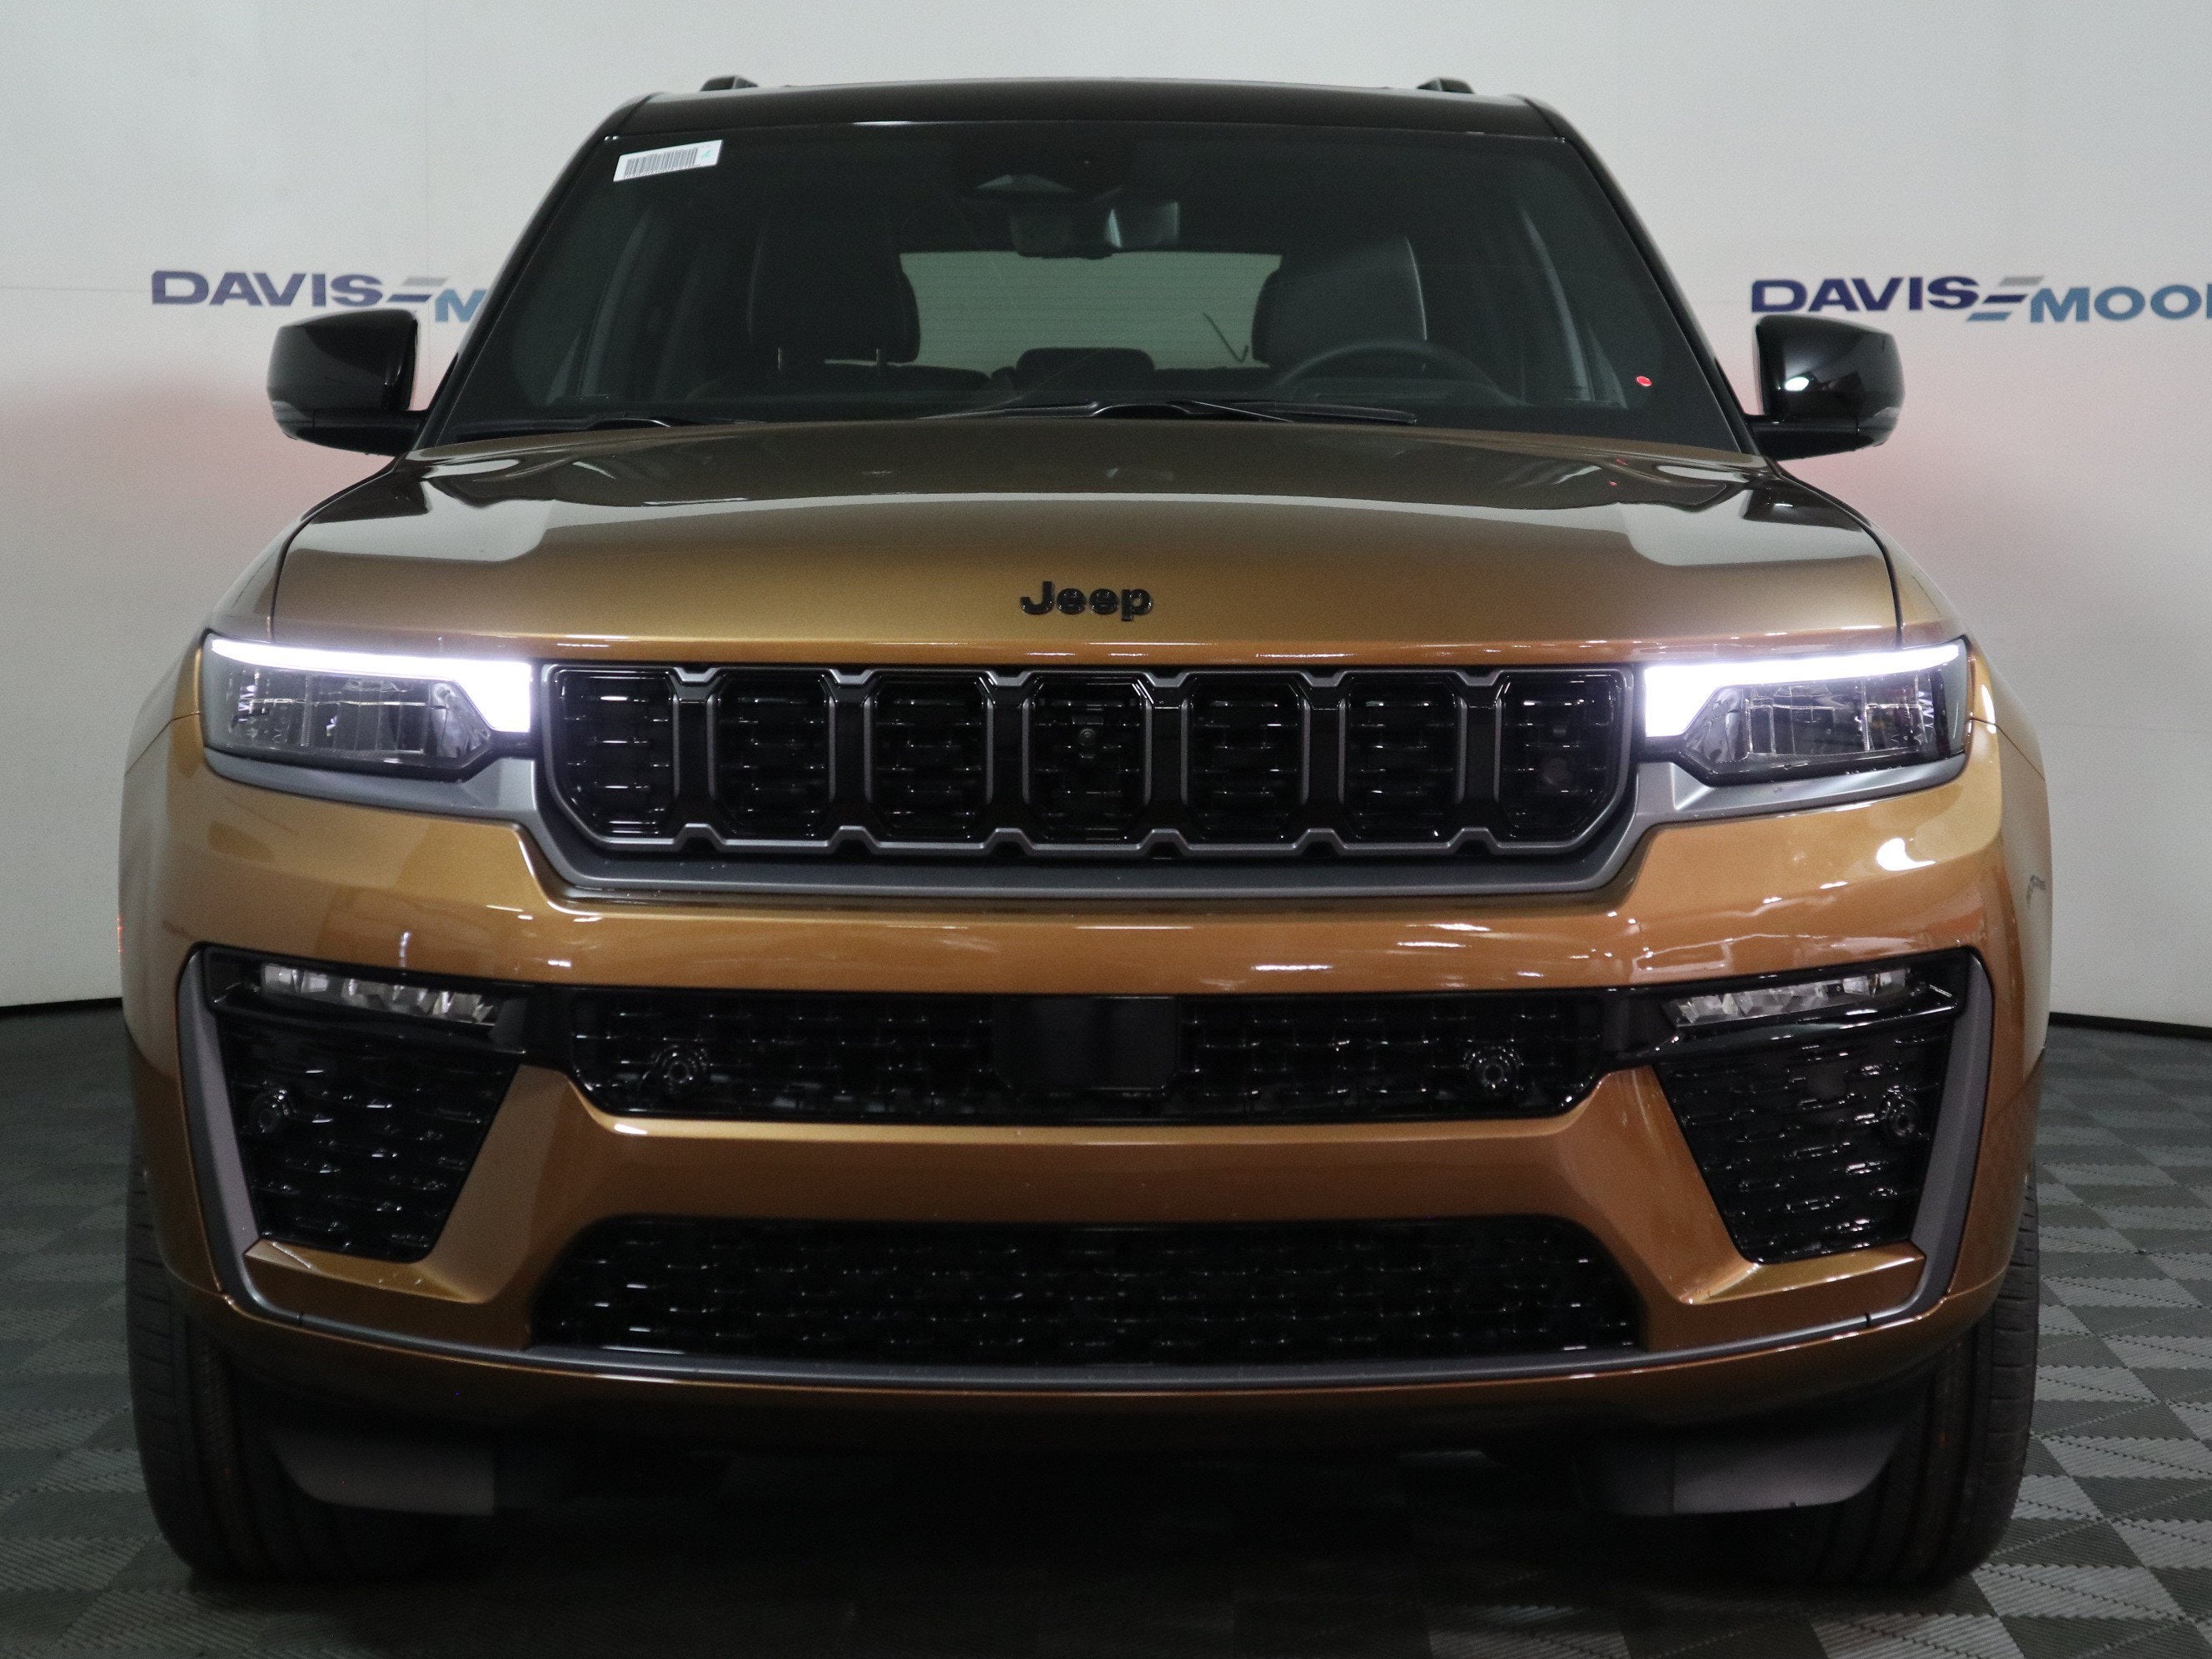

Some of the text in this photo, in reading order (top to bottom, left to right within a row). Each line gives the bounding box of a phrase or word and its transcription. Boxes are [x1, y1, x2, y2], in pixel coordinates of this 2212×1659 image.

[151, 270, 384, 307] DAVIS
[1751, 276, 2212, 323] DAVIS MOO
[1019, 580, 1153, 621] Jeep
